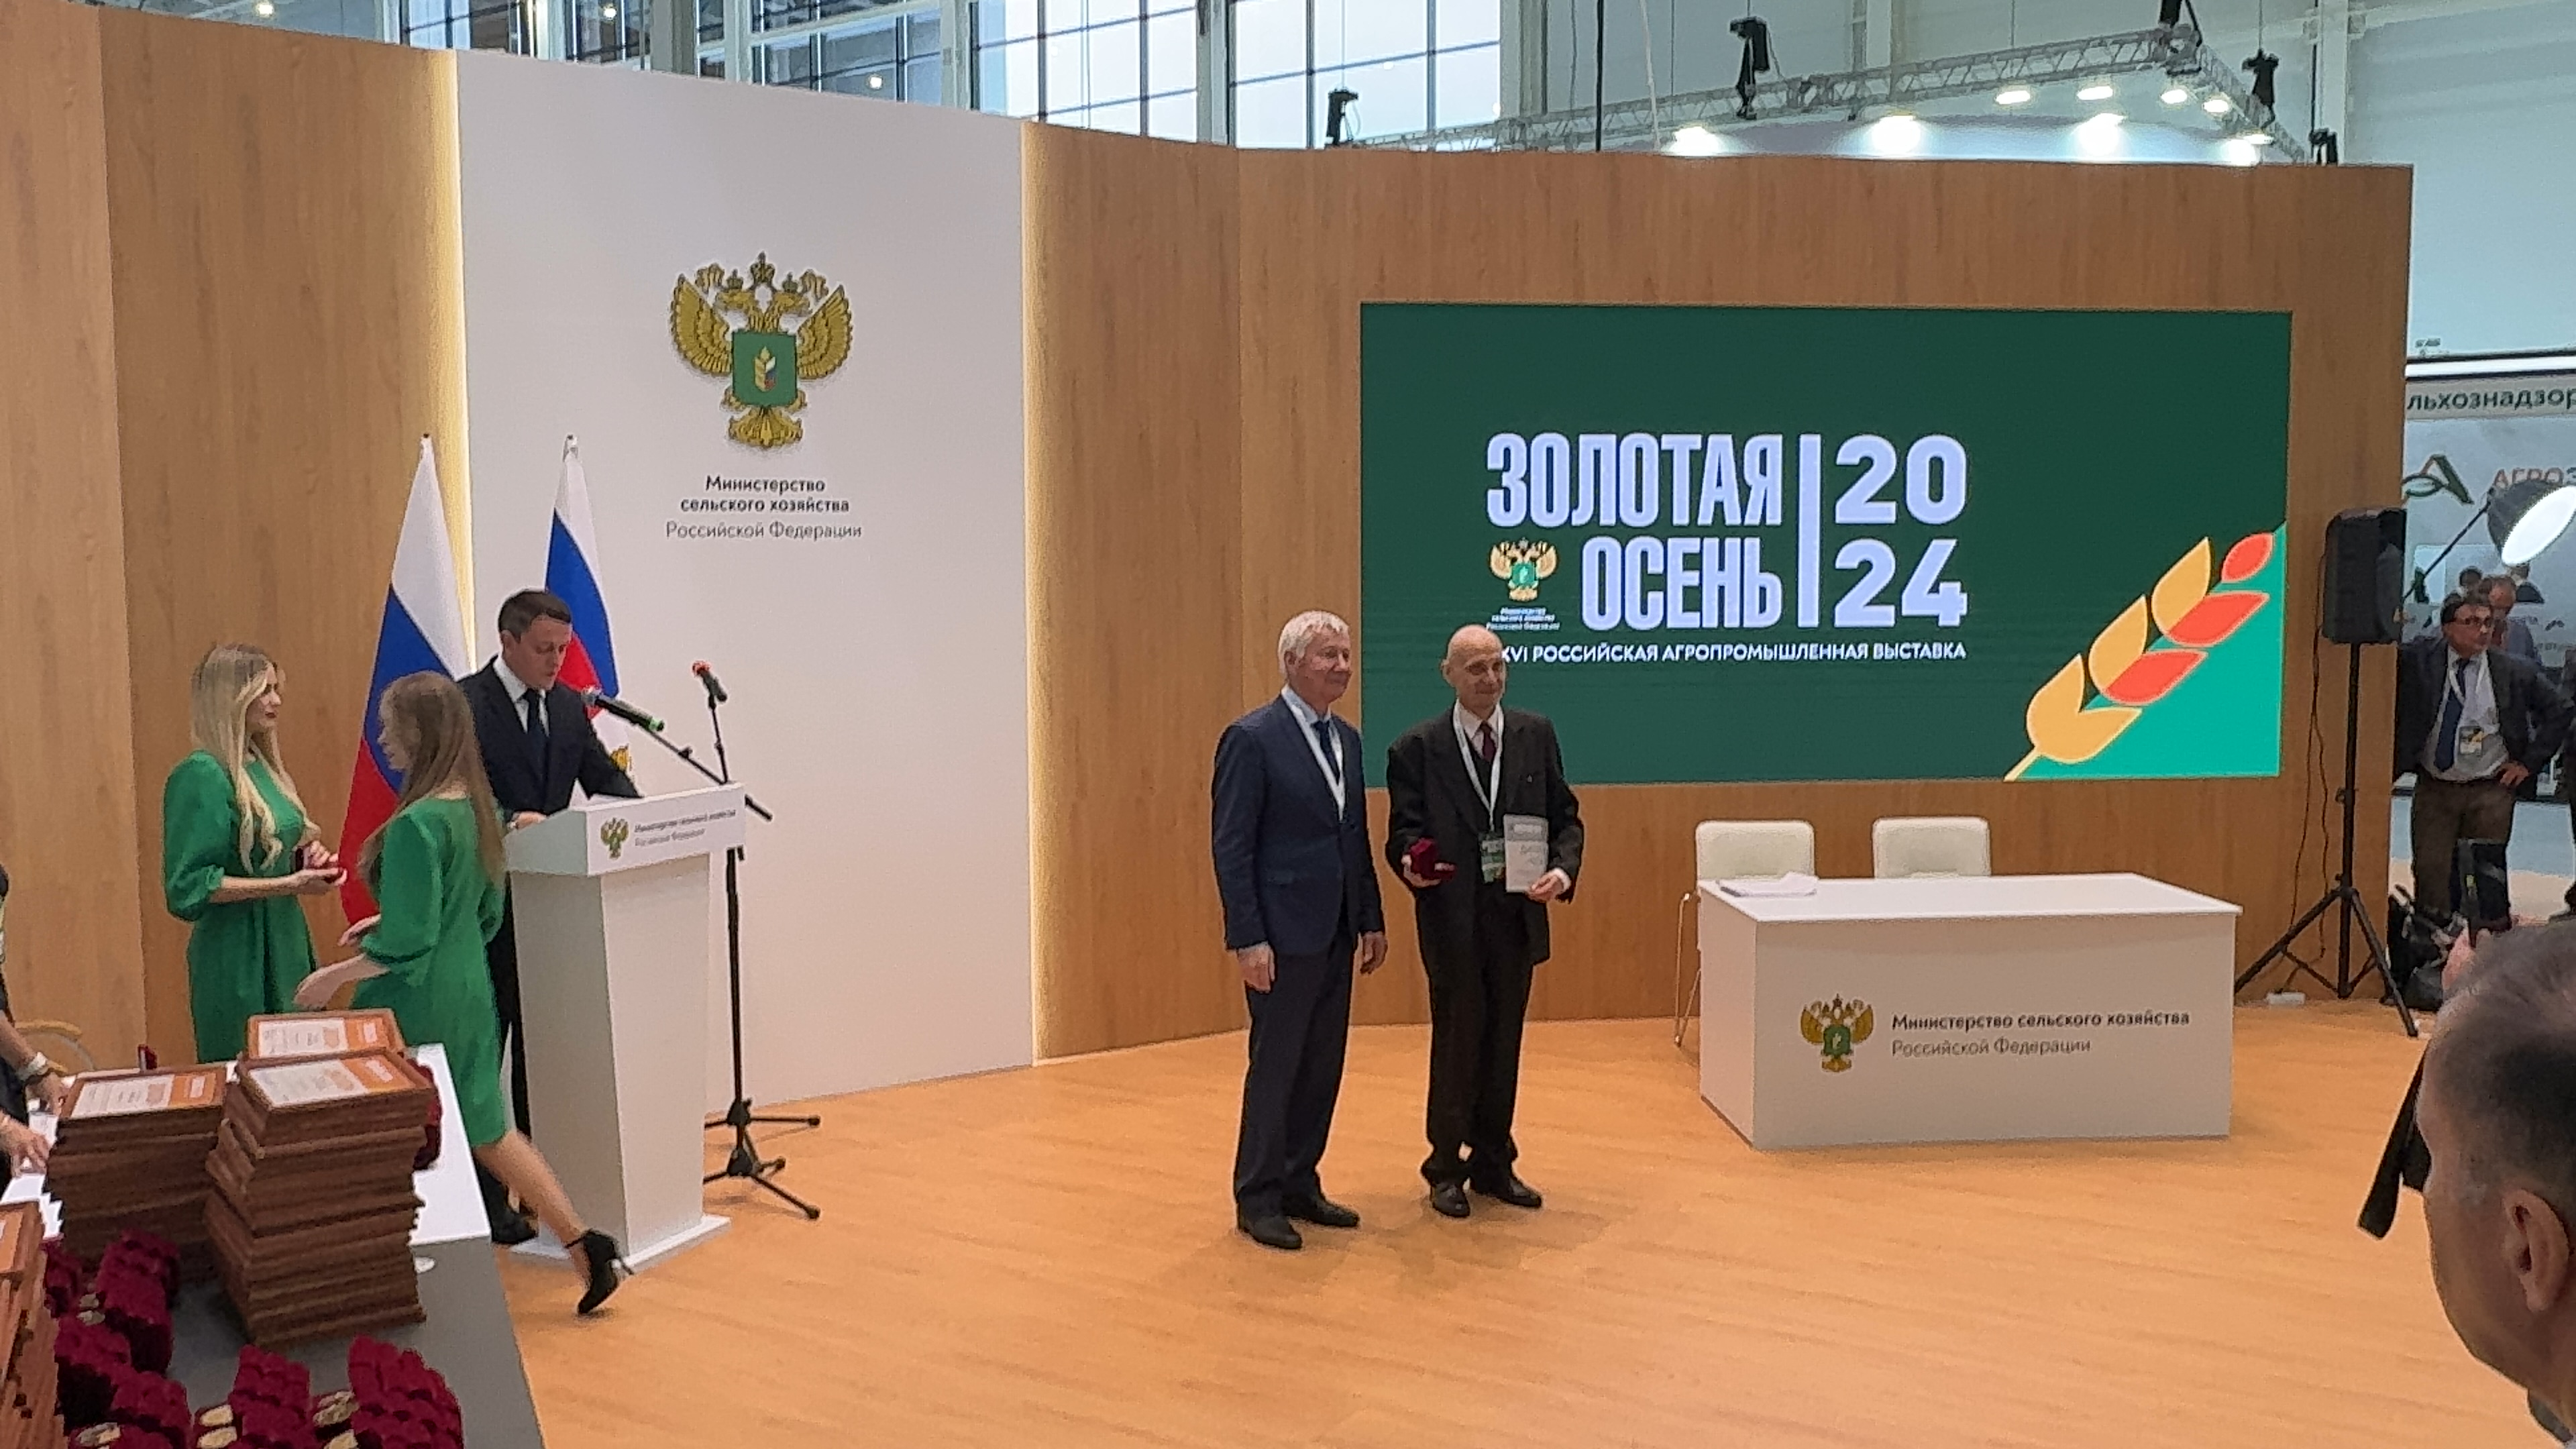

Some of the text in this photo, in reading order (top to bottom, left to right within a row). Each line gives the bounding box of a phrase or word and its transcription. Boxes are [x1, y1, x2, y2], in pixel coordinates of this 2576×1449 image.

[706, 475, 825, 495] Министерство
[1487, 433, 1782, 527] ЗОЛОТАЯ
[1835, 435, 1967, 524] 20
[680, 496, 849, 513] сельского хозяйства
[667, 521, 862, 541] Российской Федерации
[1582, 537, 1782, 631] ОСЕНЬ
[1834, 539, 1968, 627] 24
[1532, 642, 1658, 663] РОССИЙСКАЯ
[1662, 643, 1868, 661] АГРОПРОМЫШЛЕННАЯ
[1873, 642, 1966, 659] ВЫСТАВКА
[1892, 1009, 2190, 1033] Министерство сельского хозяйства
[1892, 1037, 2091, 1057] Российской Федерации
